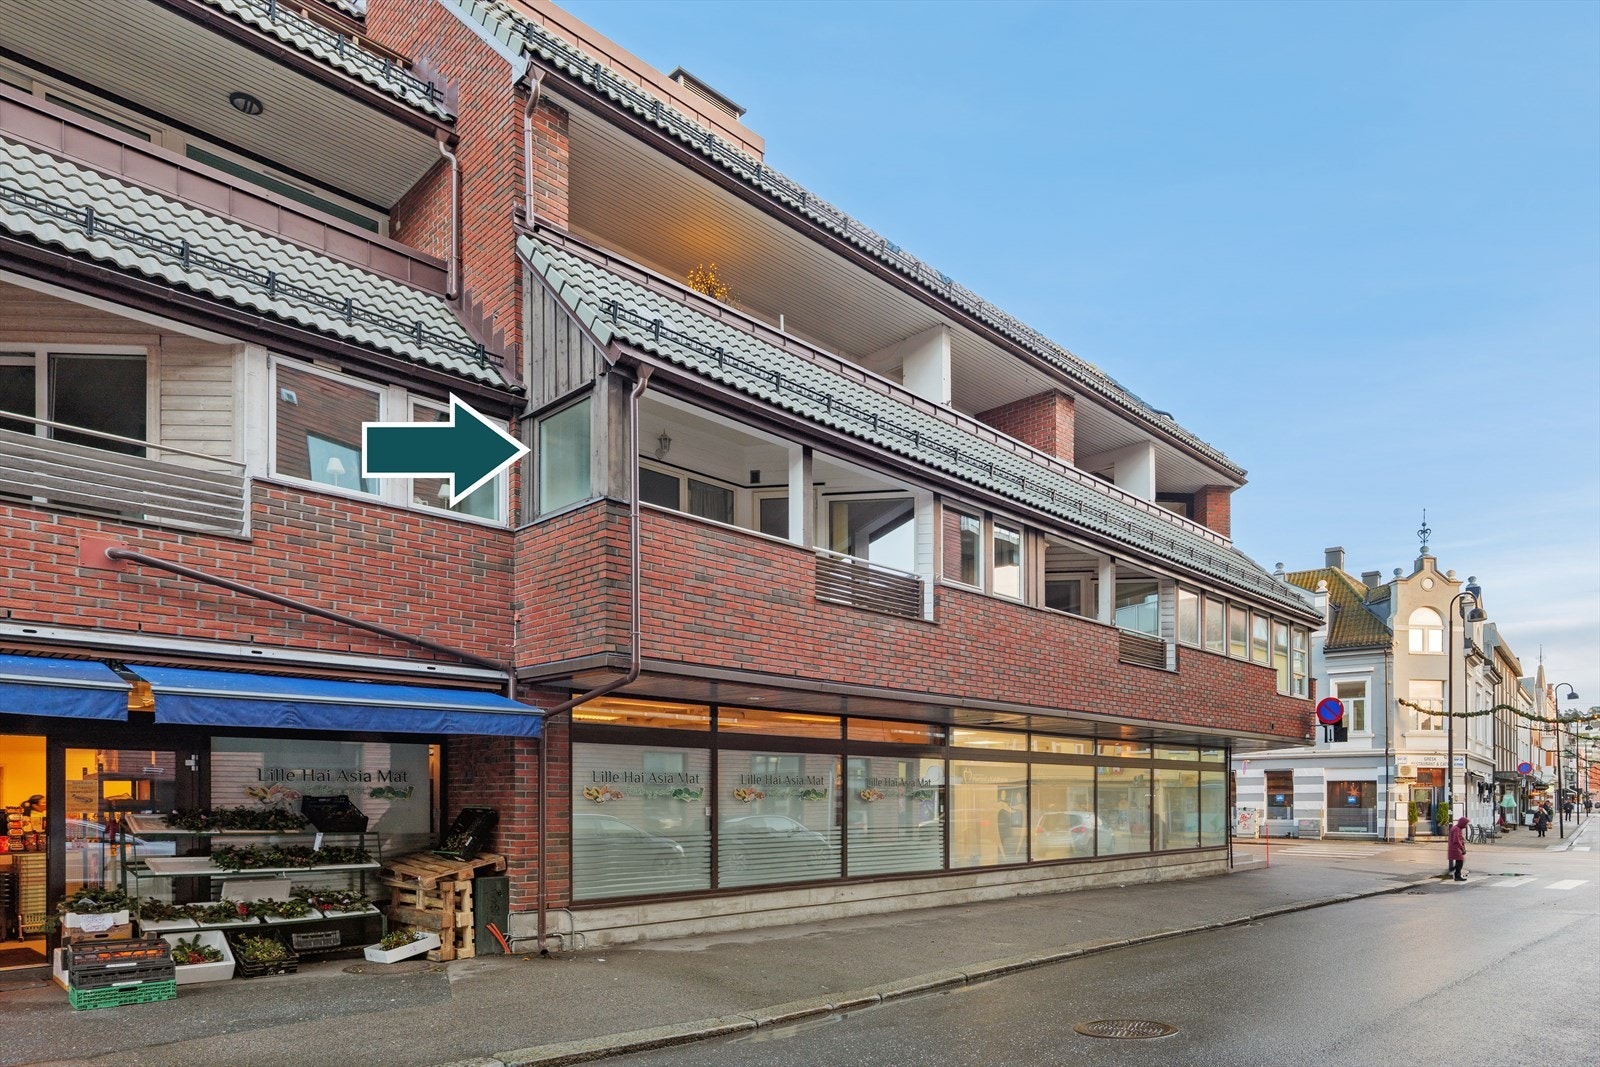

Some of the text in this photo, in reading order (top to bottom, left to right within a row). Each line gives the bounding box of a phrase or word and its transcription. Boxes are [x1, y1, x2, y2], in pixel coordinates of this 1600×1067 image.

[257, 767, 409, 783] Lille Hai Asia Mat
[592, 770, 700, 784] Lille Hai Asia Mat
[740, 773, 825, 786] Lille Hai Asia Mat
[866, 777, 932, 787] Lille Hai Asia Mat
